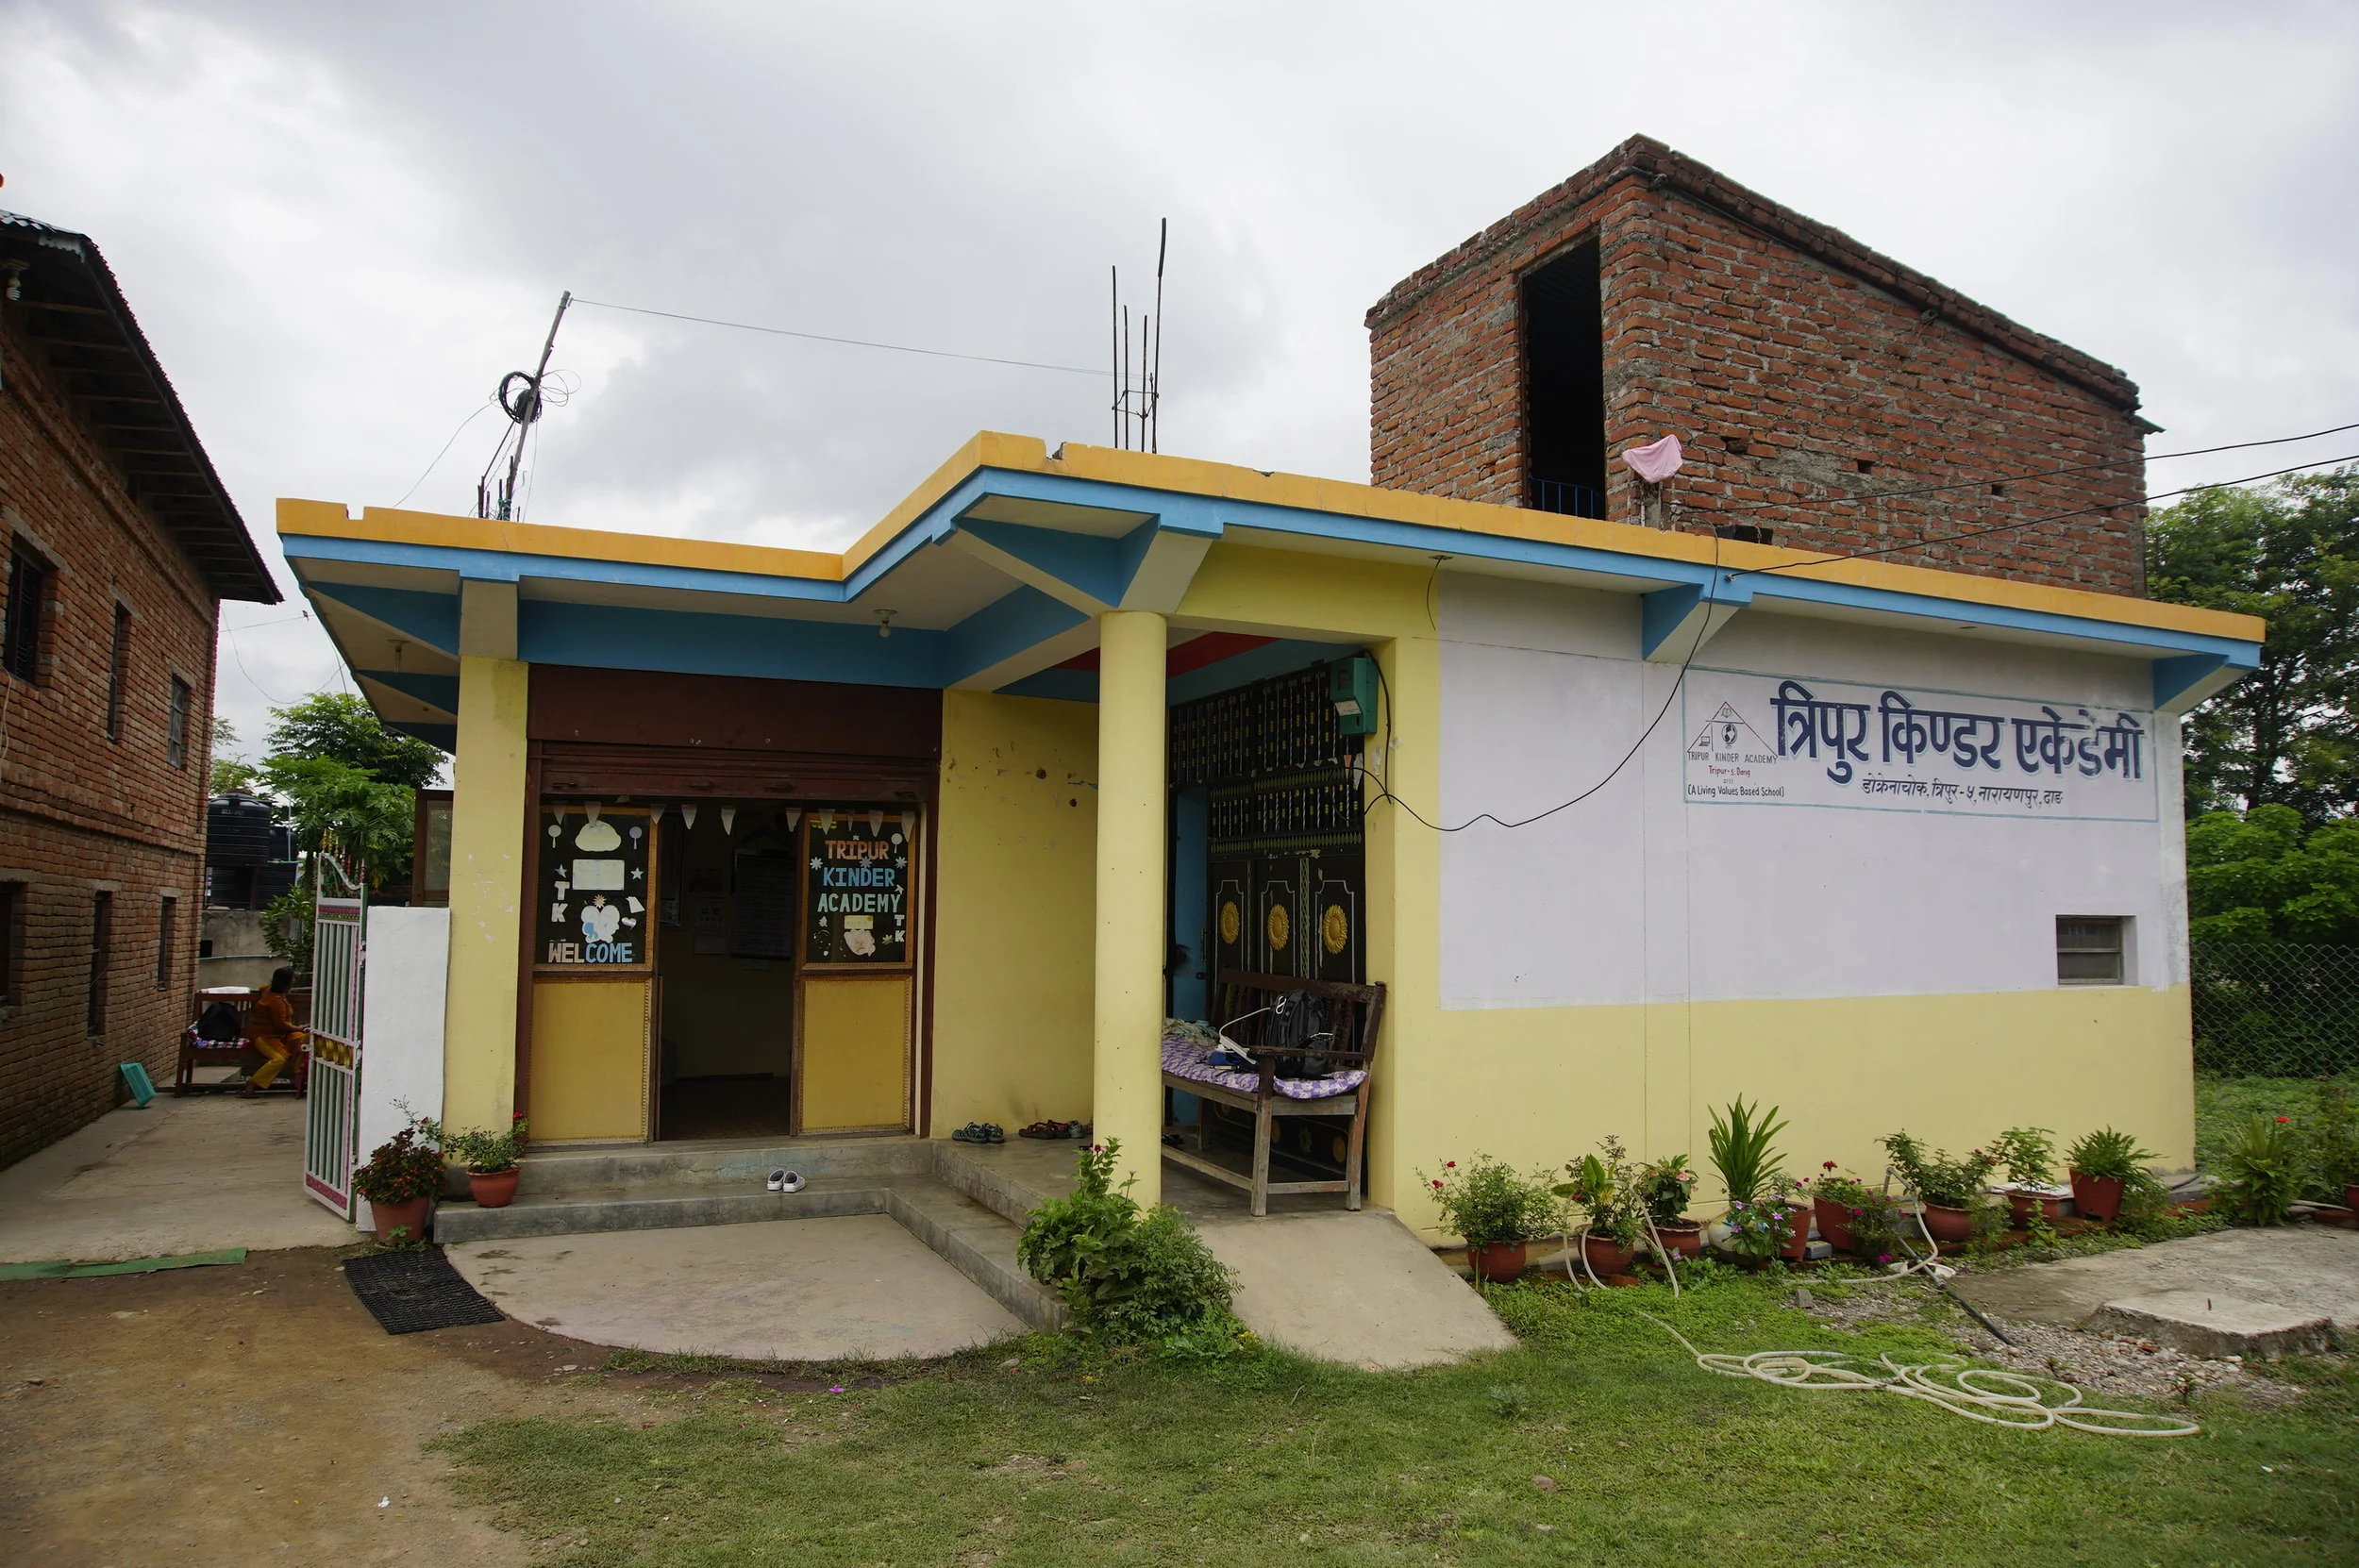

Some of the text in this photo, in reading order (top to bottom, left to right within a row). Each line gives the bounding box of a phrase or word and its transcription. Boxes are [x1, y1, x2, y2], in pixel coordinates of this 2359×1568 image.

[1770, 680, 1871, 784] त्रिपुर
[1878, 691, 2005, 770] किण्डर
[1688, 751, 1778, 765] TRIPUR KINDER ACADEMY
[1697, 784, 1716, 798] Living
[1717, 786, 1739, 796] Values
[1740, 786, 1760, 796] Based
[825, 840, 890, 860] TRIPUR
[823, 867, 895, 887] KINDER
[817, 892, 901, 913] ACADEMY
[547, 942, 633, 963] WELCOME
